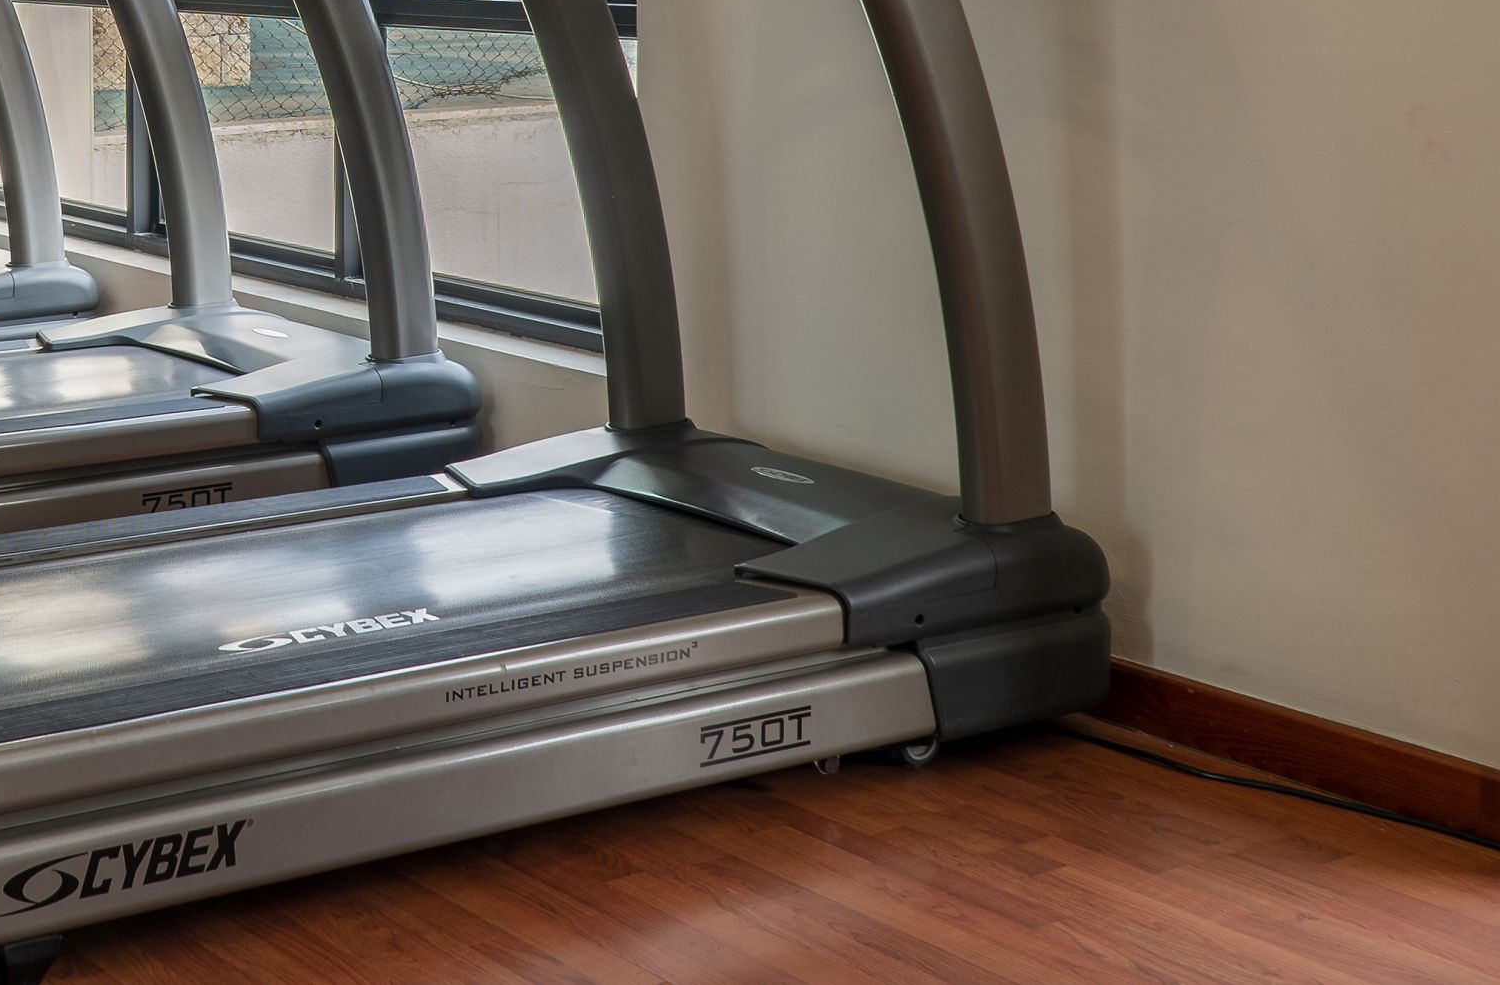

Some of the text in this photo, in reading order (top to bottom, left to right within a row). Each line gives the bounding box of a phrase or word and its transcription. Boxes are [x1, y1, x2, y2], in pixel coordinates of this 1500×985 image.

[289, 607, 441, 645] CYBEX
[444, 670, 567, 703] INTELLIGENT
[699, 711, 812, 761] 750T
[79, 818, 247, 900] CYBEX
